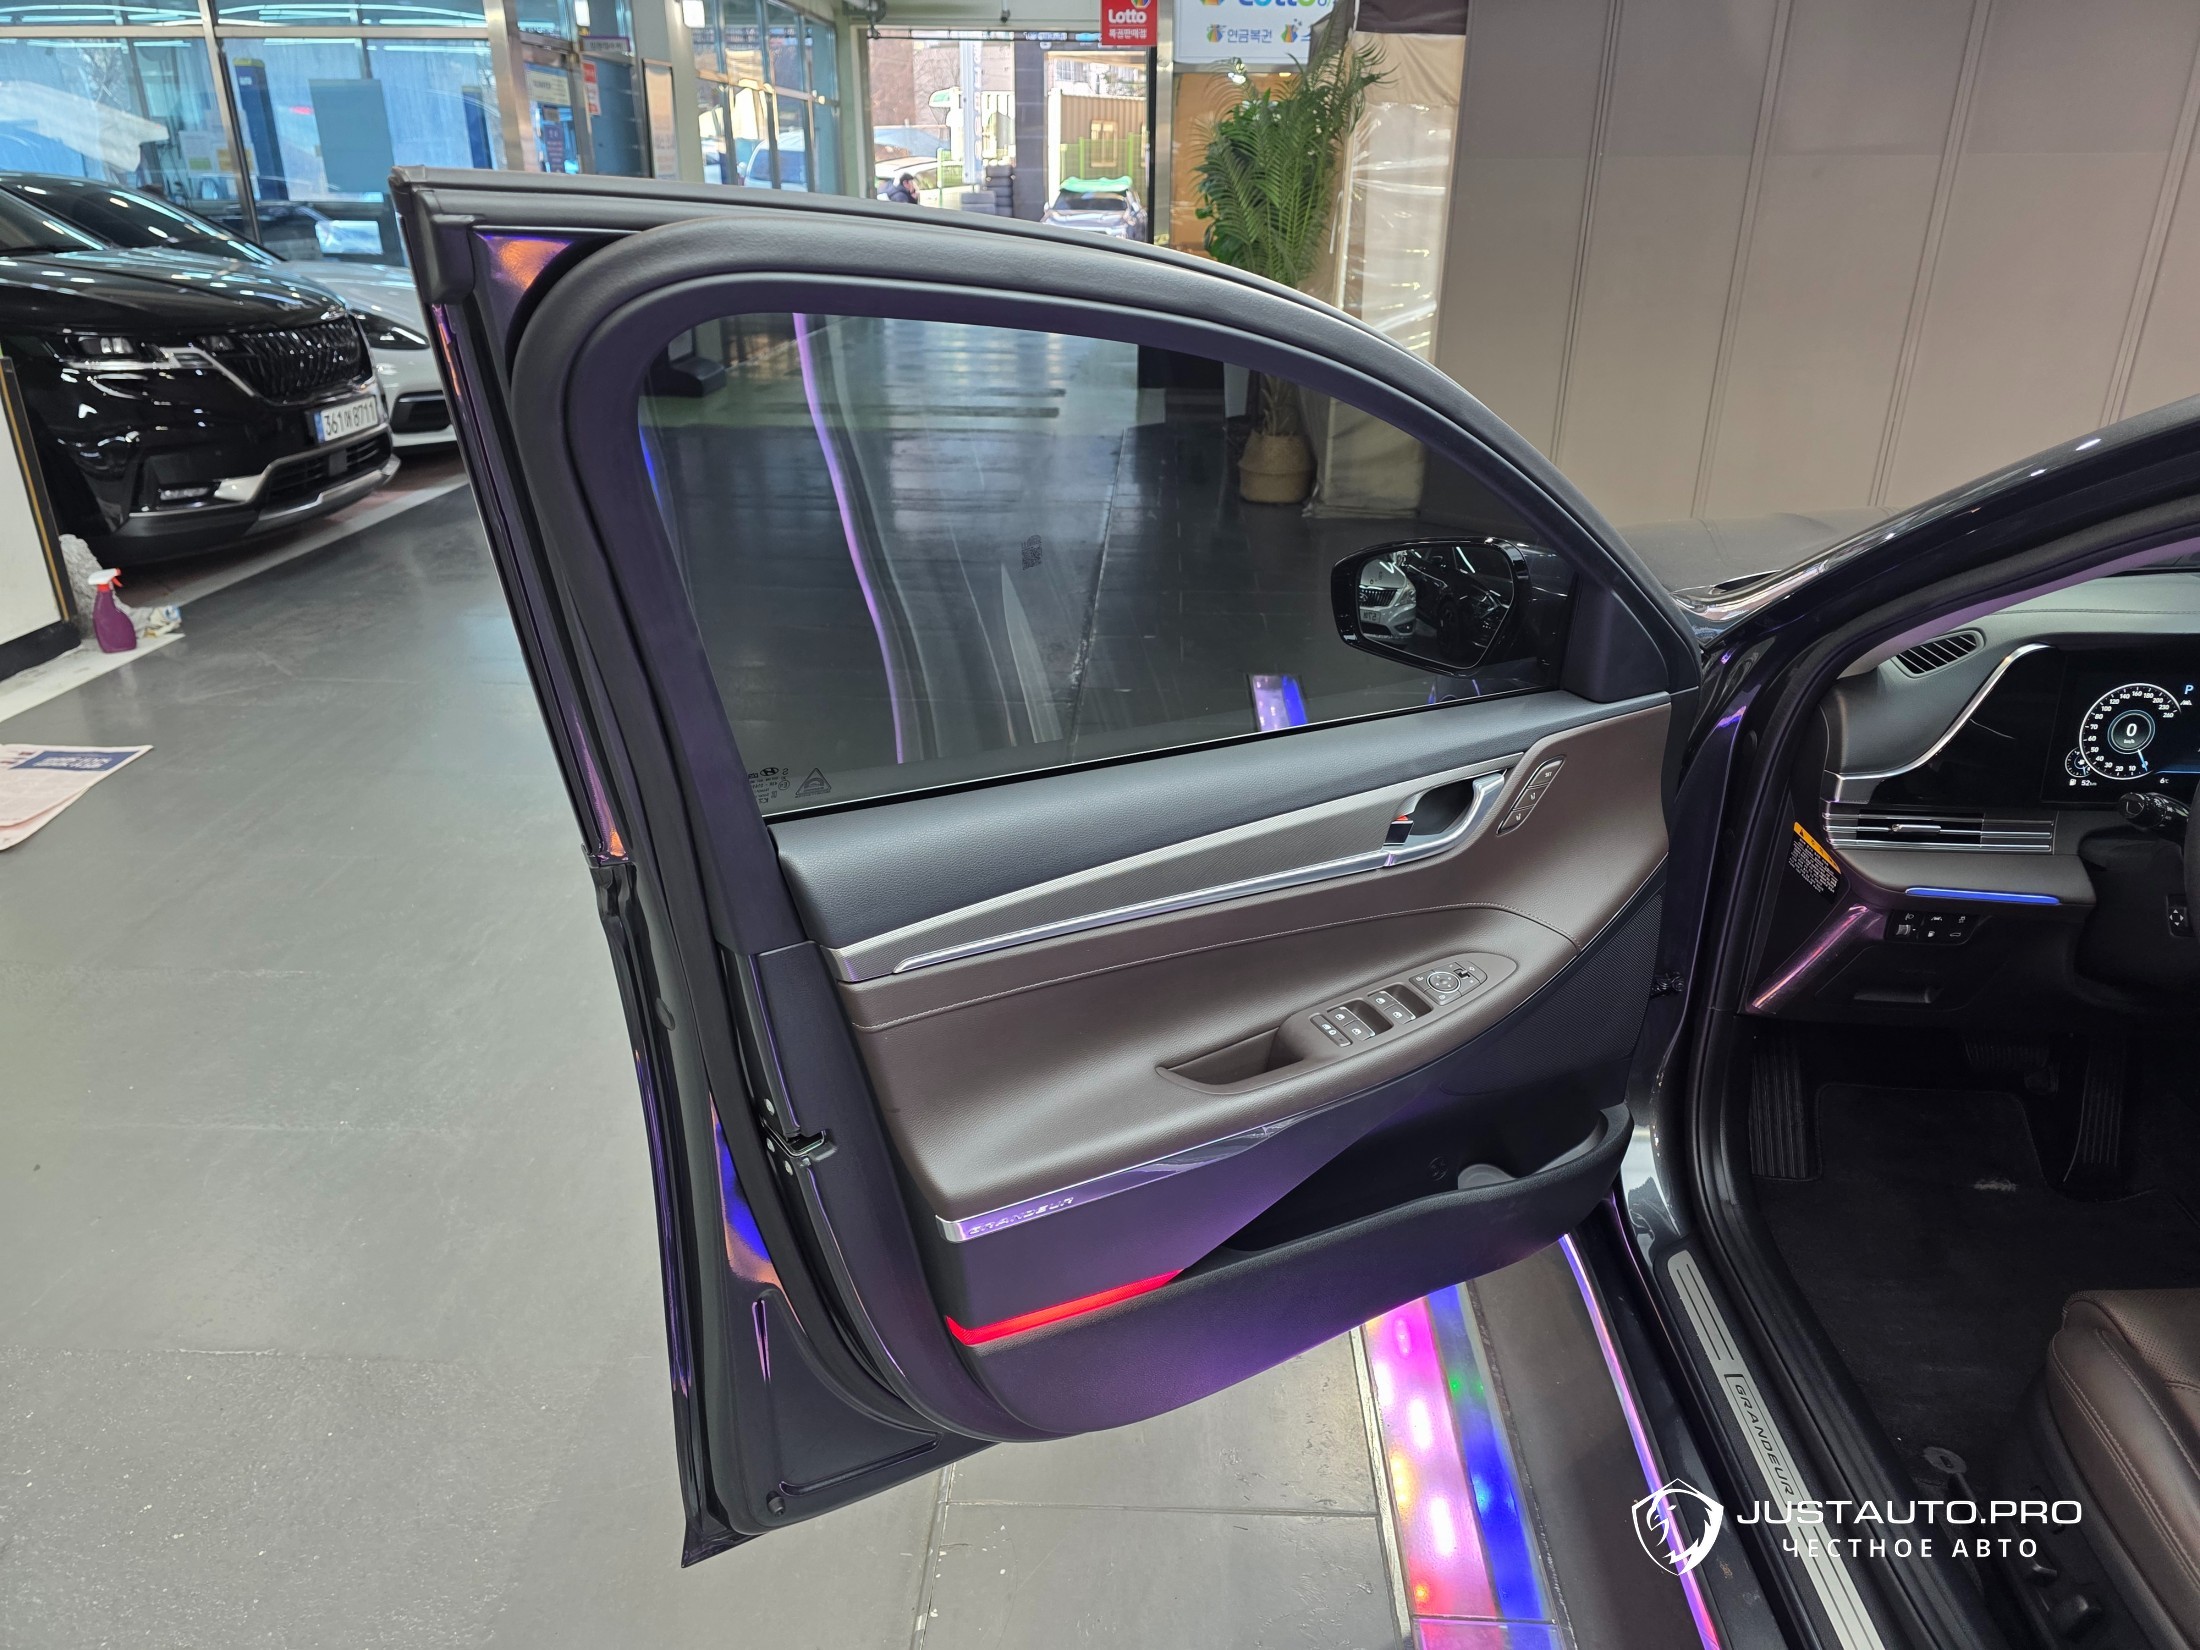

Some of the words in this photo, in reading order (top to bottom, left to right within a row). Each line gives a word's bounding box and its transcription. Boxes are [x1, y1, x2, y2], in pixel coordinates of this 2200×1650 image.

[1107, 9, 1148, 25] Lotto
[1108, 28, 1148, 39] 복권판매점
[1226, 29, 1273, 44] 연금복권
[2185, 685, 2194, 694] P
[2126, 723, 2137, 736] 0
[1734, 1383, 1796, 1497] GRANDEUR
